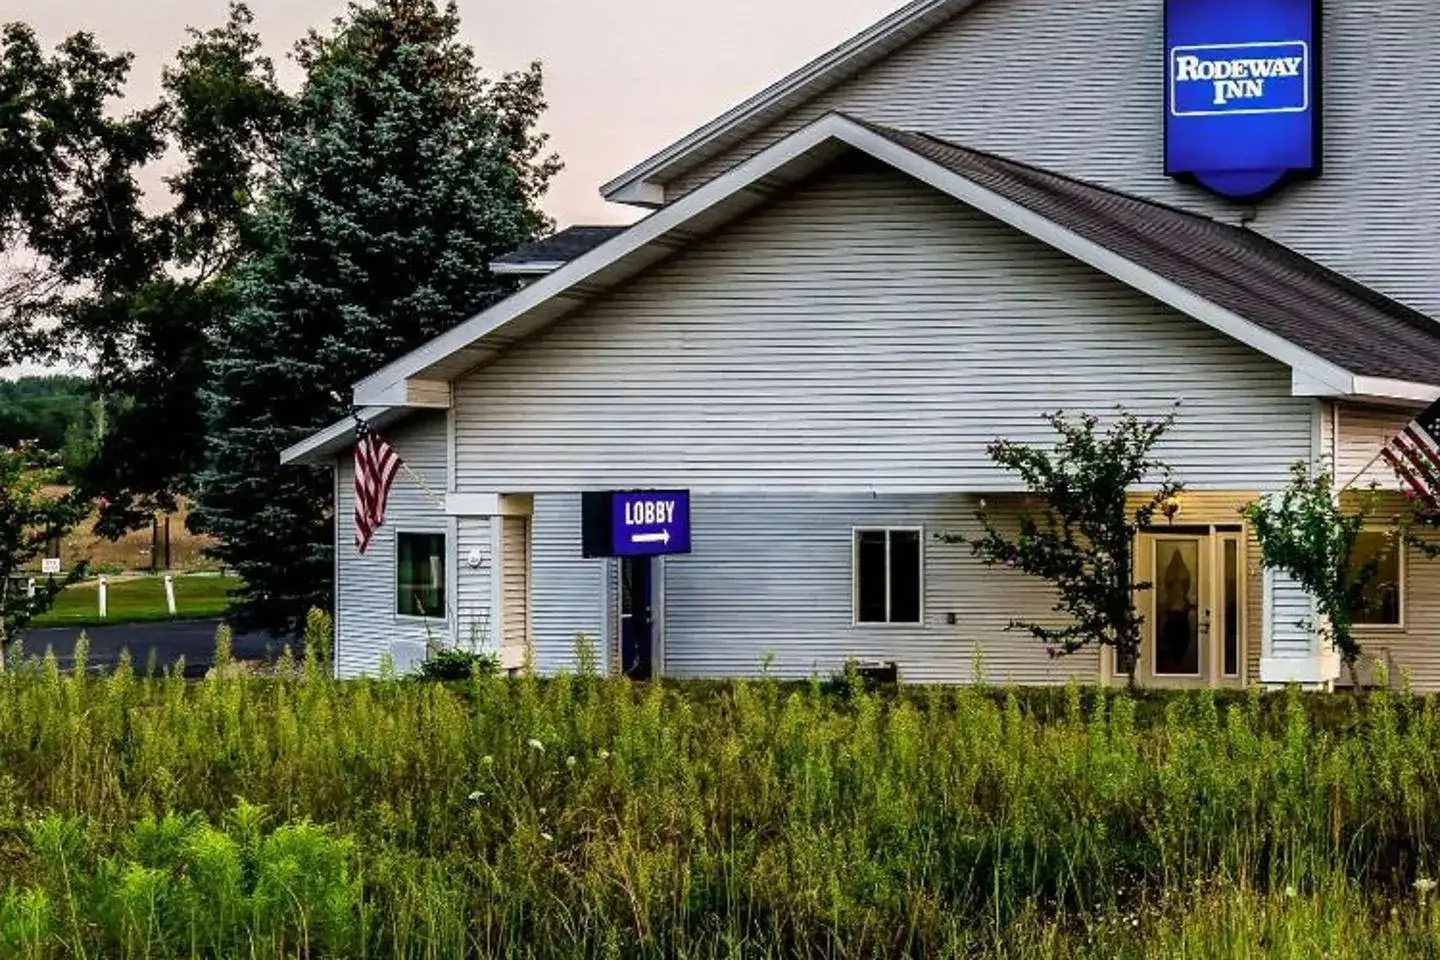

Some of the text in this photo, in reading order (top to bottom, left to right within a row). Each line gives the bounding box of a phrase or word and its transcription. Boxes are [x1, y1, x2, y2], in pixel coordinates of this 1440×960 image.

[1176, 56, 1302, 81] RODEWAY
[1213, 80, 1264, 104] INN
[625, 501, 674, 525] LOBBY
